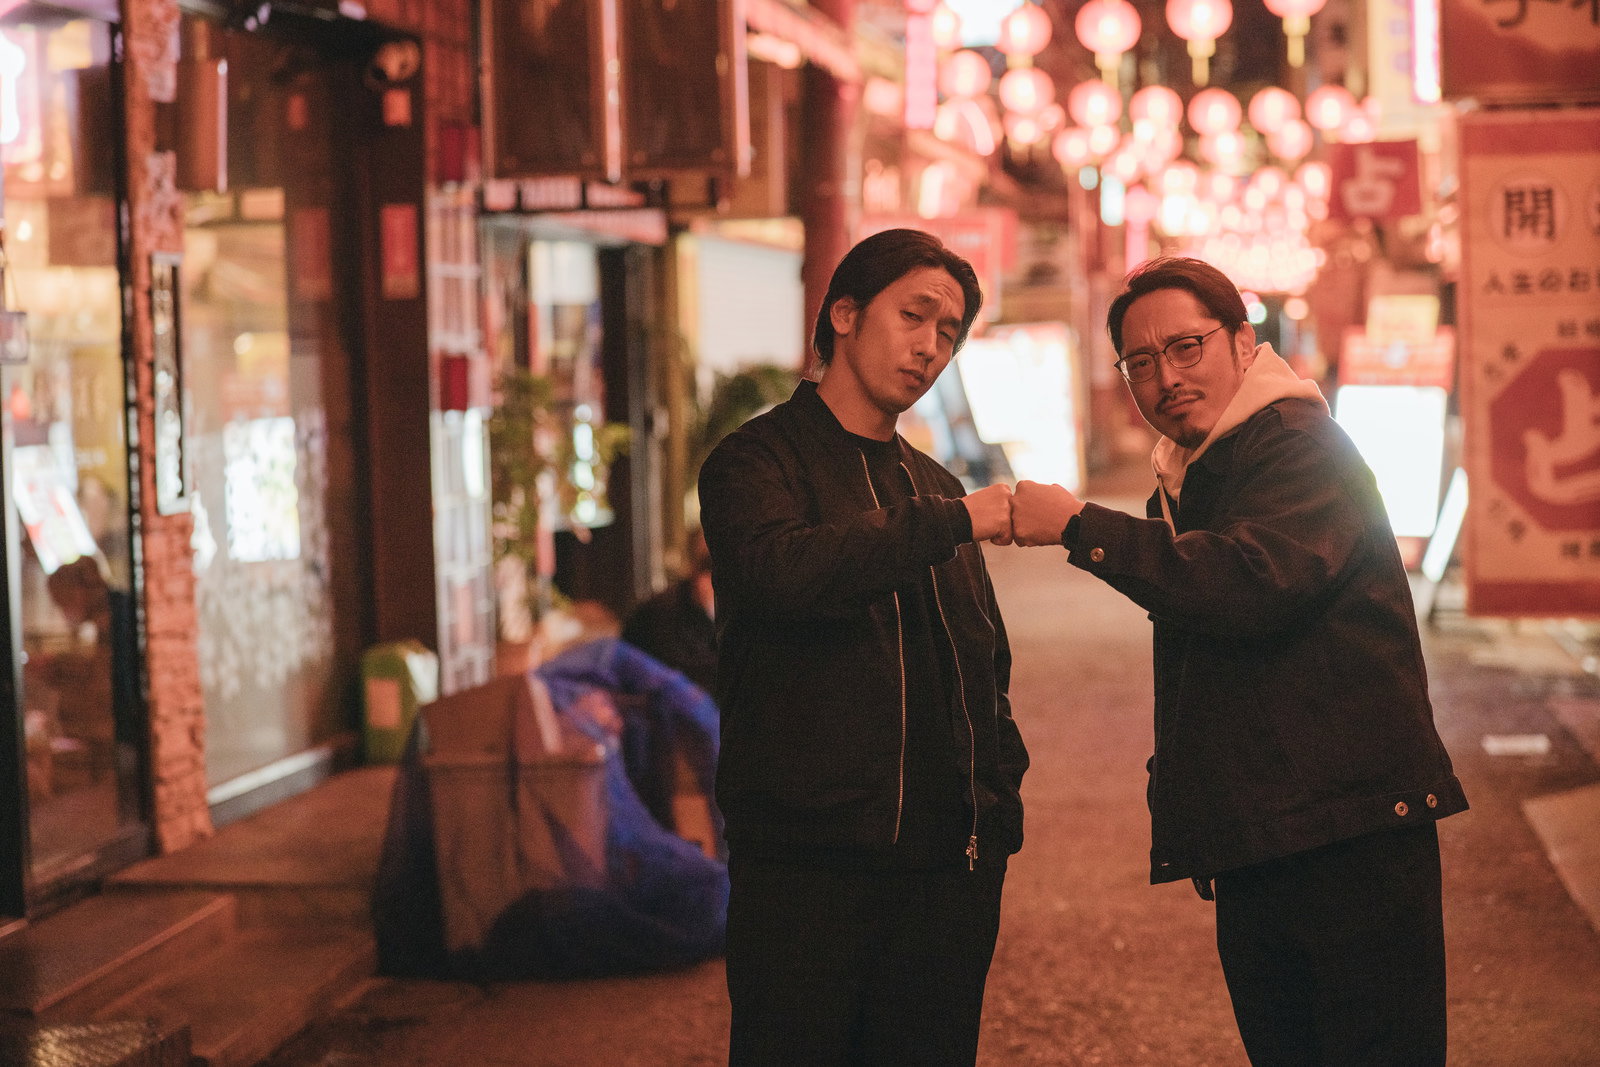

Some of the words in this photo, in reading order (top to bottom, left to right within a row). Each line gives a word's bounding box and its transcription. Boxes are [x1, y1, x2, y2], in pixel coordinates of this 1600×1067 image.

[1342, 147, 1405, 215] 占
[1483, 270, 1600, 294] 人生のお
